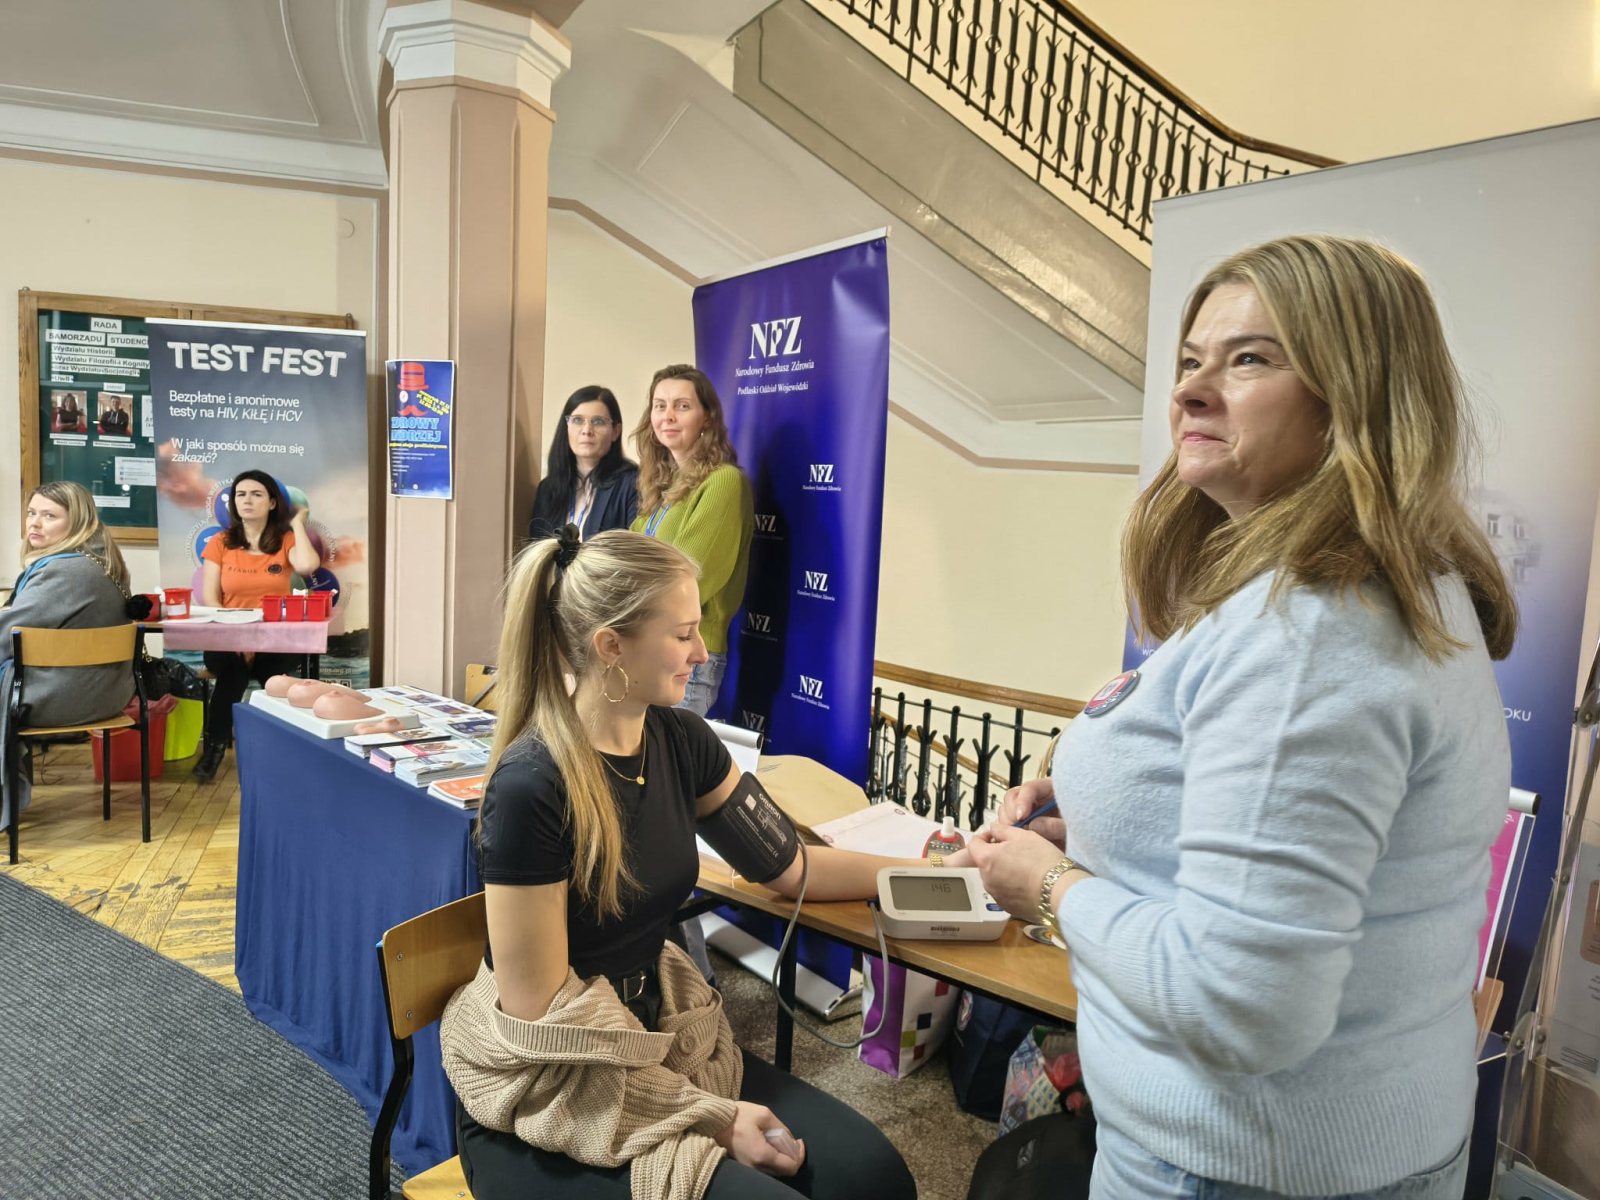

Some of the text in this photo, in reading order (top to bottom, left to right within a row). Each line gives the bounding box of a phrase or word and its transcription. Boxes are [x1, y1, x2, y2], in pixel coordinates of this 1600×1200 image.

[94, 321, 118, 330] RADA
[48, 332, 148, 346] SAMORZĄDU STUDENC
[748, 316, 802, 359] NFZ
[122, 360, 150, 369] Kognity
[167, 341, 347, 377] TEST FEST
[735, 360, 815, 377] Narodowy Fundusz Zdrowia
[737, 386, 759, 395] Podlaski
[778, 381, 809, 393] Wojewódzki
[169, 390, 300, 408] Bezpłatne i anonimowe
[170, 406, 303, 424] testy na HIV, KIŁĘ i HCV
[171, 437, 305, 457] W jaki sposób można się
[171, 451, 218, 464] zakazić?
[809, 463, 834, 483] NFZ
[755, 513, 776, 532] NFZ
[804, 570, 828, 592] NFZ
[748, 611, 770, 633] NFZ
[799, 674, 823, 700] NFZ
[1503, 707, 1532, 722] OKU
